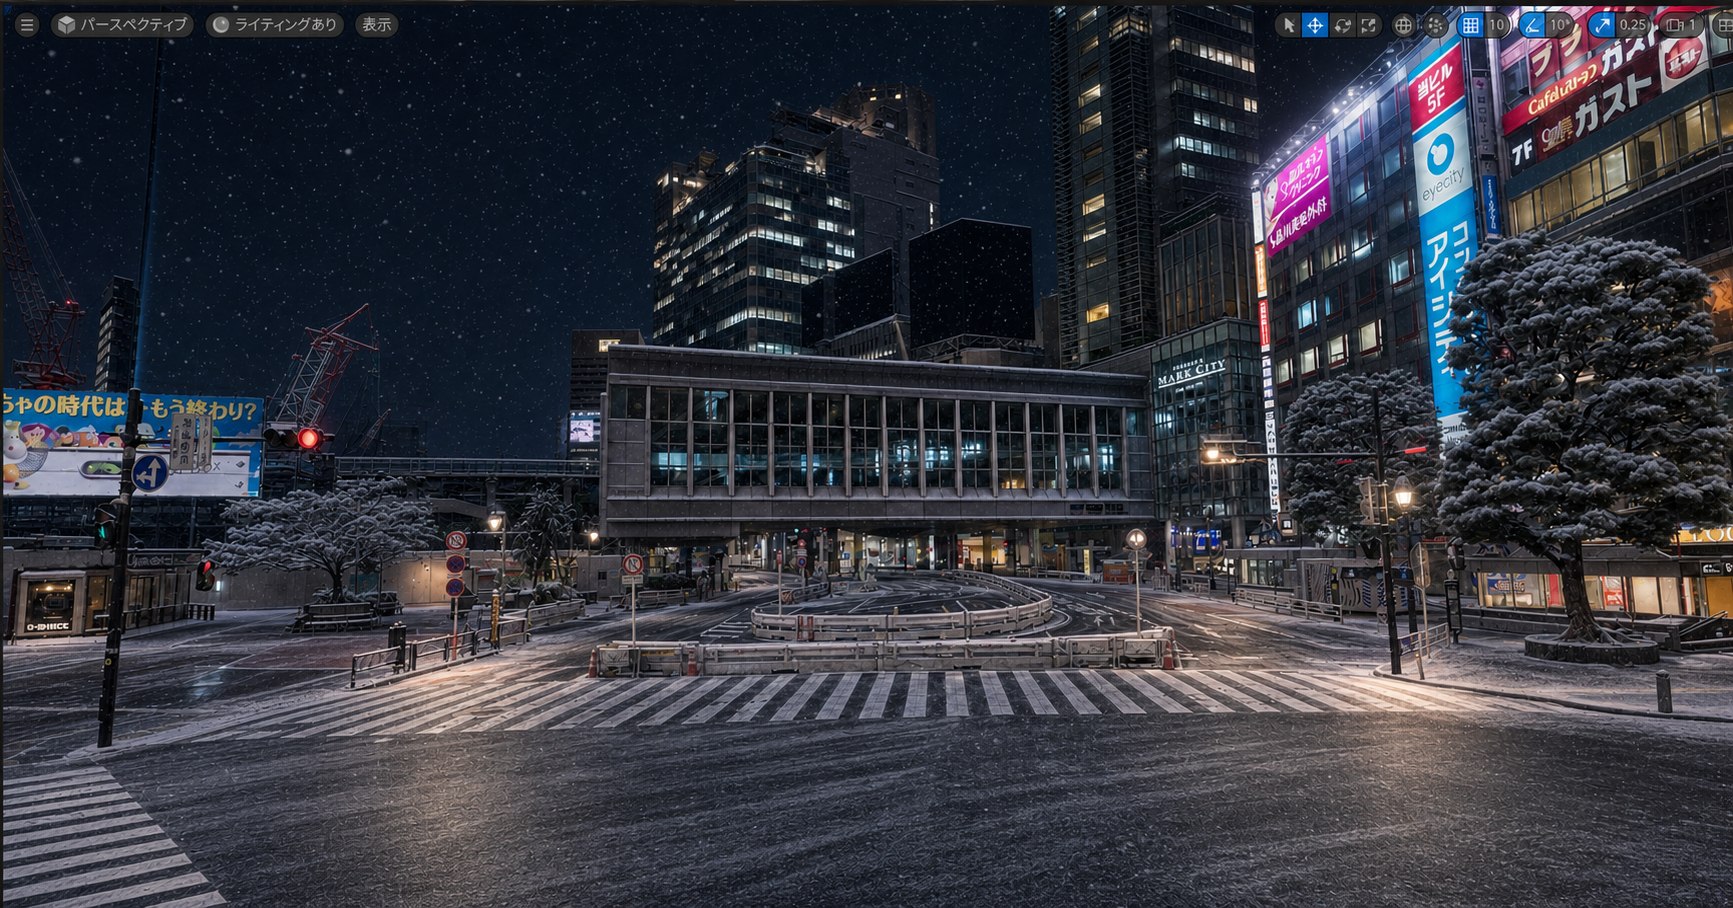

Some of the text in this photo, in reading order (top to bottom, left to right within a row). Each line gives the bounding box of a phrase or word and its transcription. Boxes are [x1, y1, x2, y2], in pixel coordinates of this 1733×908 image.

[1417, 62, 1453, 101] 当ビル
[1427, 85, 1446, 114] 5F
[1575, 73, 1653, 138] ガスト
[1511, 138, 1533, 166] 7F
[1422, 166, 1465, 203] eyecity
[1195, 358, 1226, 375] CITY
